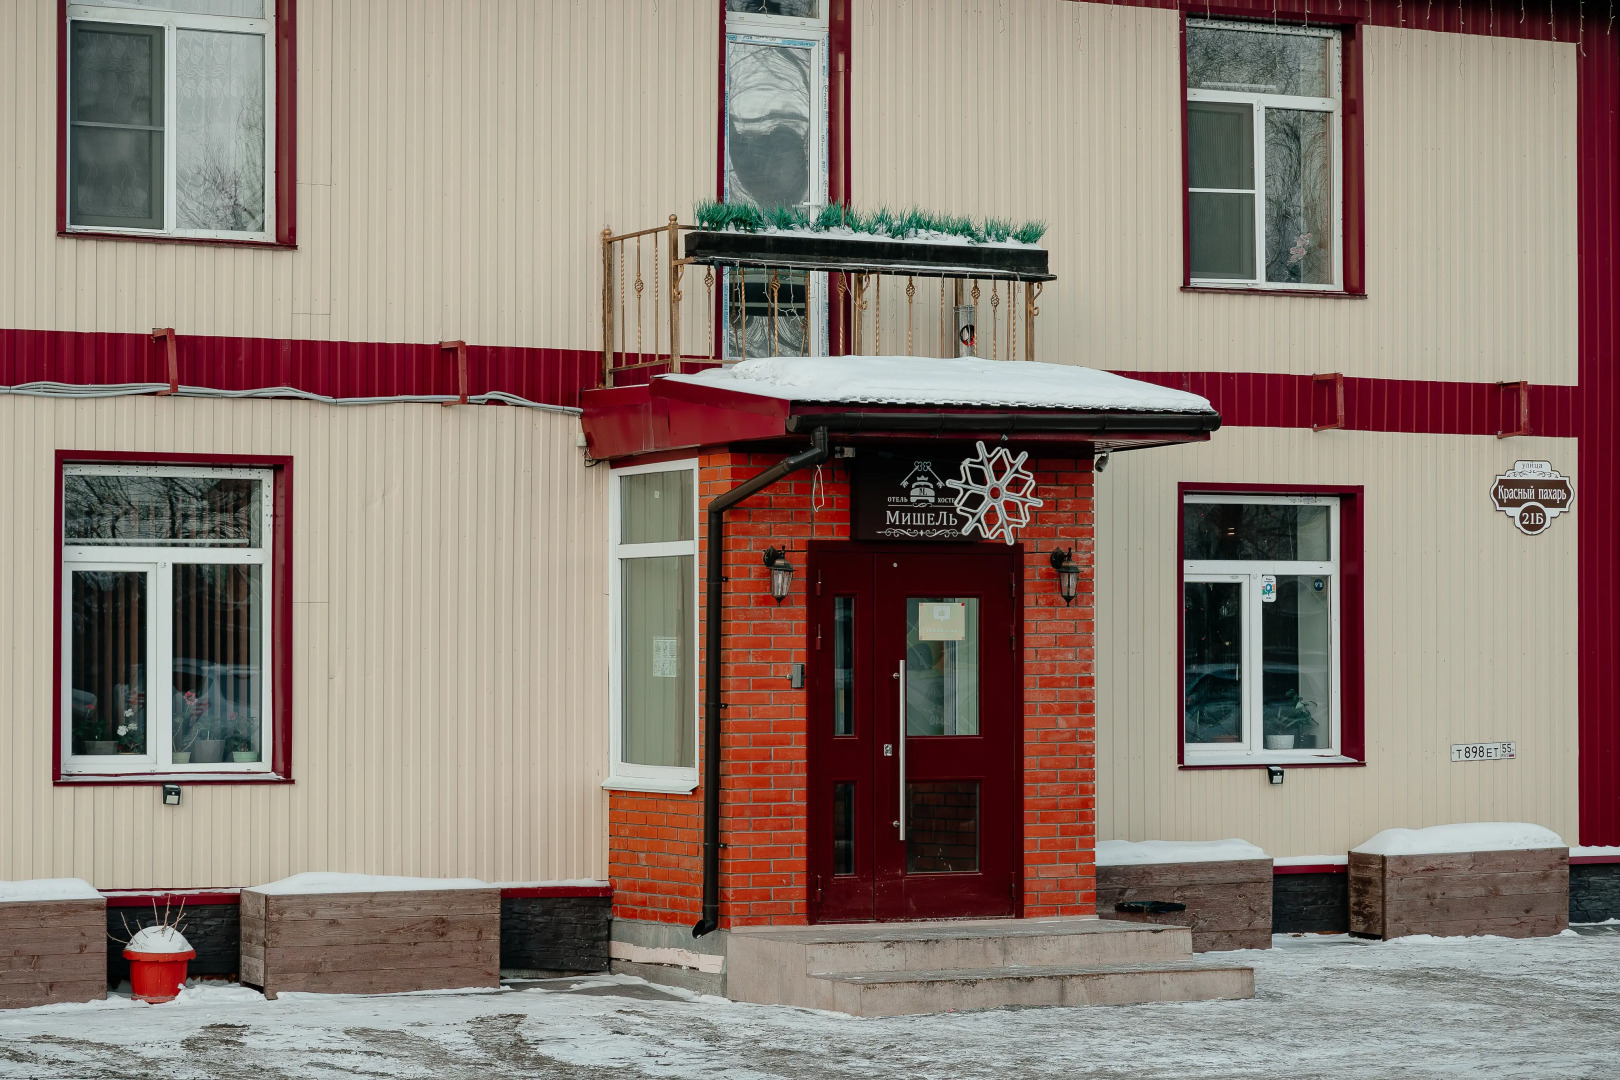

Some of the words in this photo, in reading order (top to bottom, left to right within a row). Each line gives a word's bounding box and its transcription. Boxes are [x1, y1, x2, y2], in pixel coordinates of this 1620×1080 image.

[1521, 462, 1543, 470] улица
[1498, 485, 1535, 503] Красный
[1538, 488, 1567, 504] пахарь
[1521, 512, 1544, 525] 21Б
[1501, 743, 1512, 754] 55
